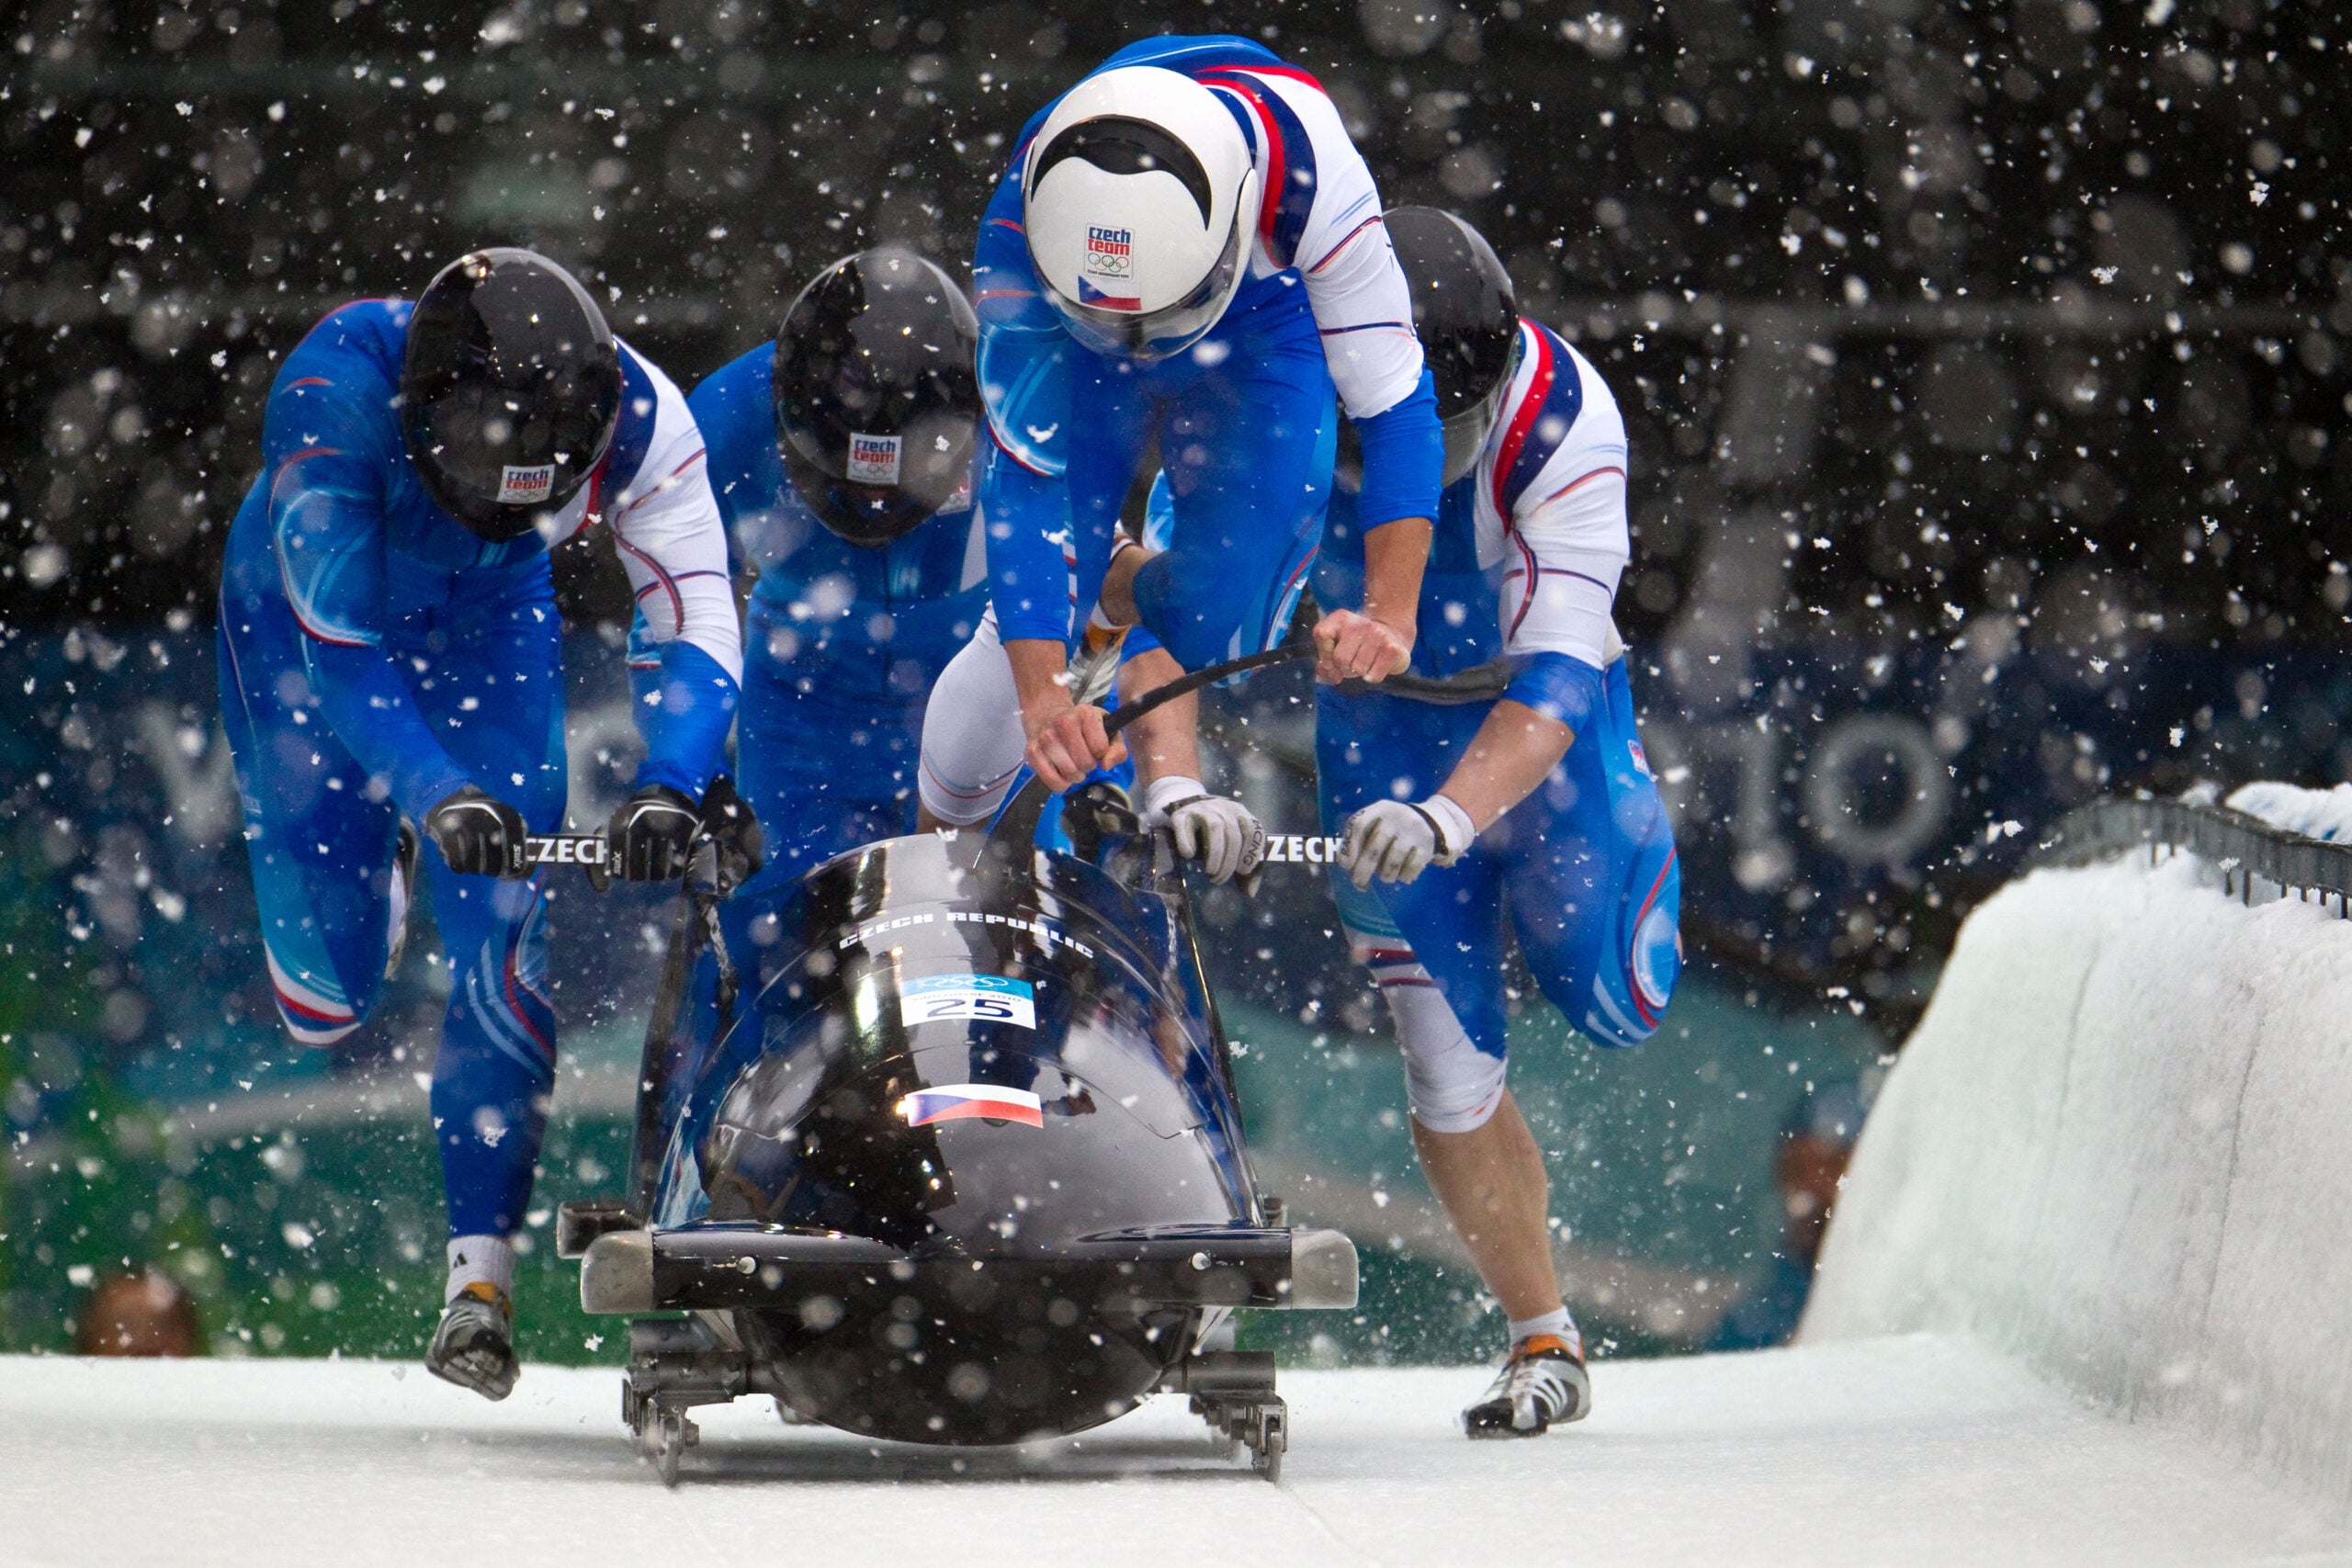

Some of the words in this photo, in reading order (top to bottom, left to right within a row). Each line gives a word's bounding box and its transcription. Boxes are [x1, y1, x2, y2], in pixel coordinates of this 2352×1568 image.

[1089, 226, 1131, 244] czech
[1088, 239, 1130, 256] team
[854, 439, 896, 453] czech
[854, 449, 896, 464] team
[507, 468, 548, 480] czech
[506, 479, 548, 490] team
[1243, 818, 1263, 865] ACING
[1260, 836, 1345, 863] ZECH
[839, 913, 933, 950] CZECH
[946, 912, 1094, 959] REPUBLIC
[926, 998, 1013, 1019] 25
